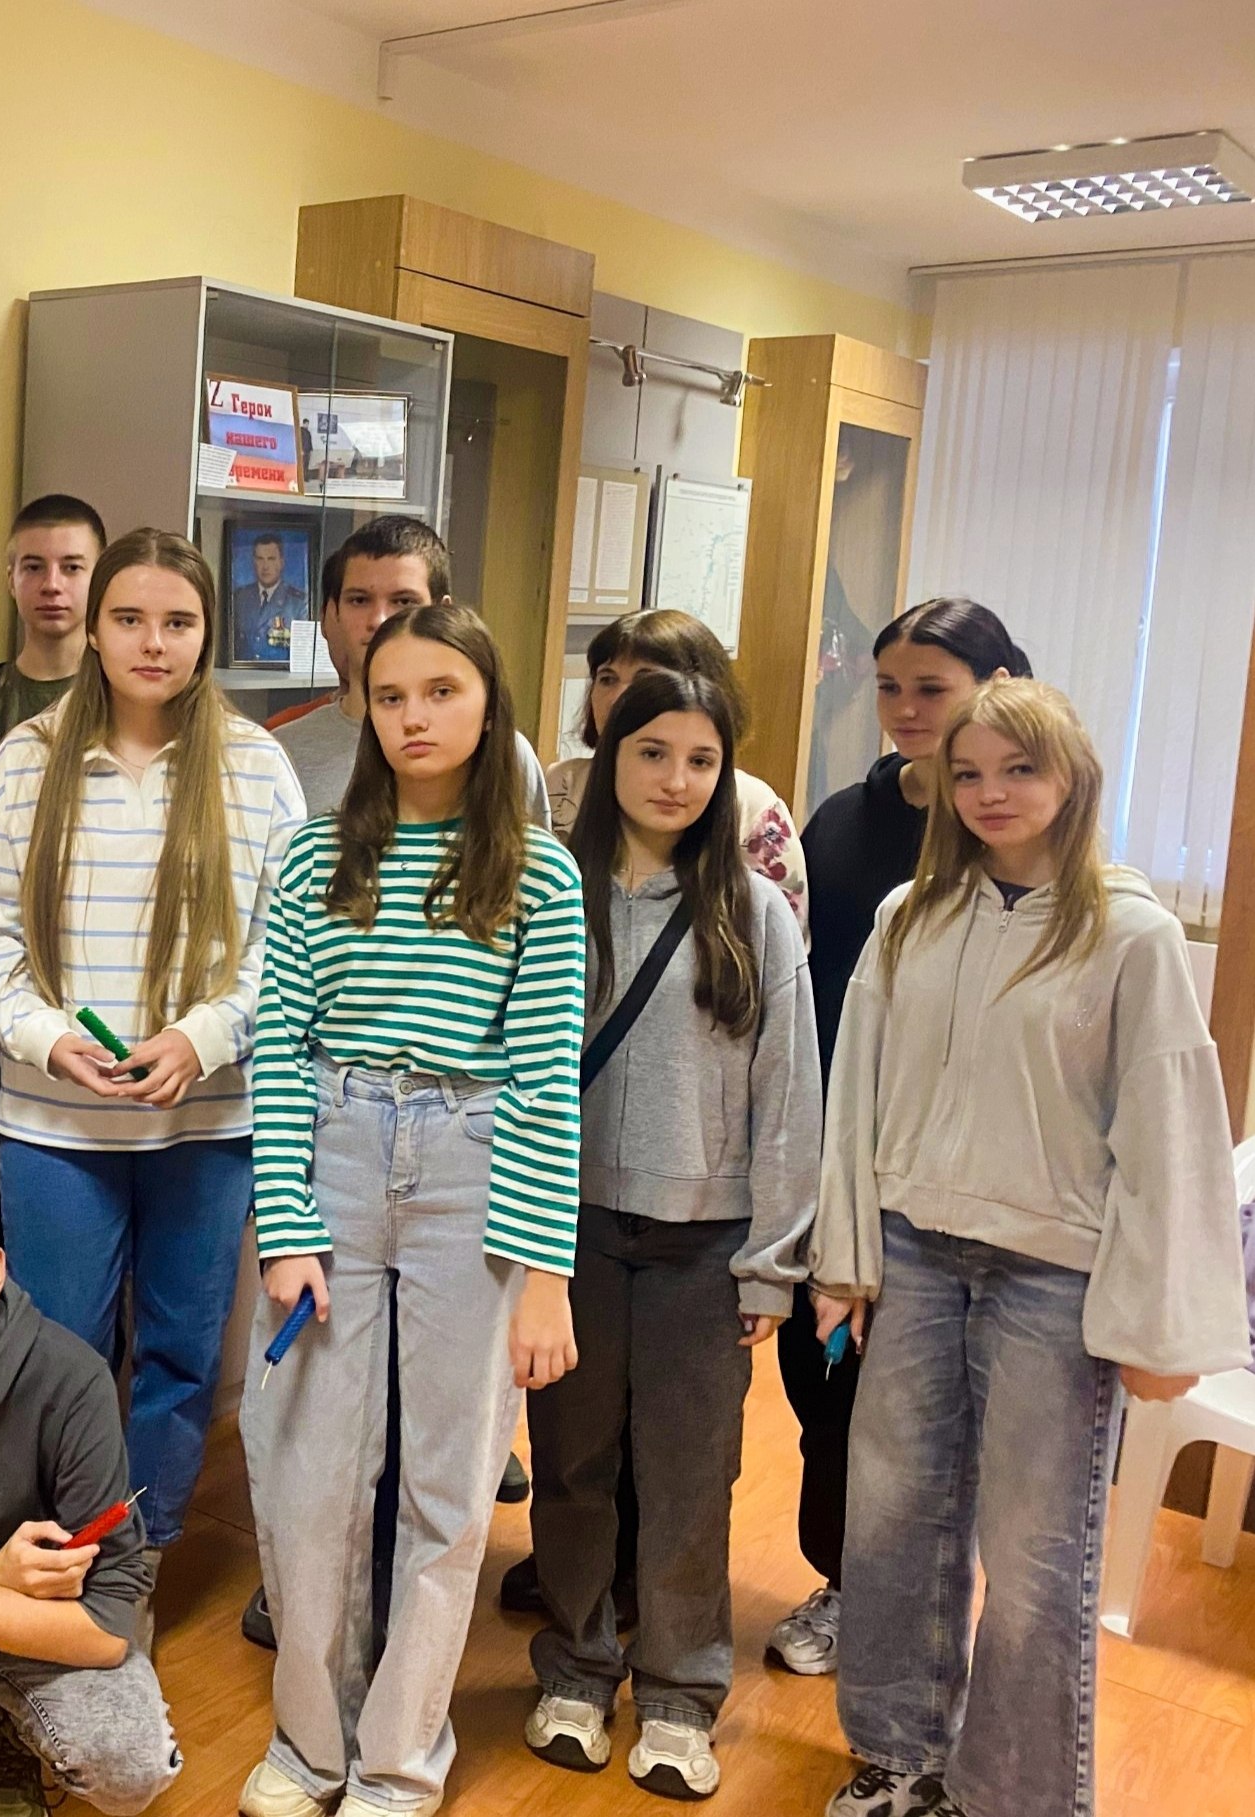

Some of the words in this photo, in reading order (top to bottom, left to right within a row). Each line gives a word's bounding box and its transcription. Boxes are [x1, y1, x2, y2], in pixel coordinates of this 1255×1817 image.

[209, 380, 224, 407] Z
[231, 393, 272, 421] Герои
[225, 431, 277, 450] нашего
